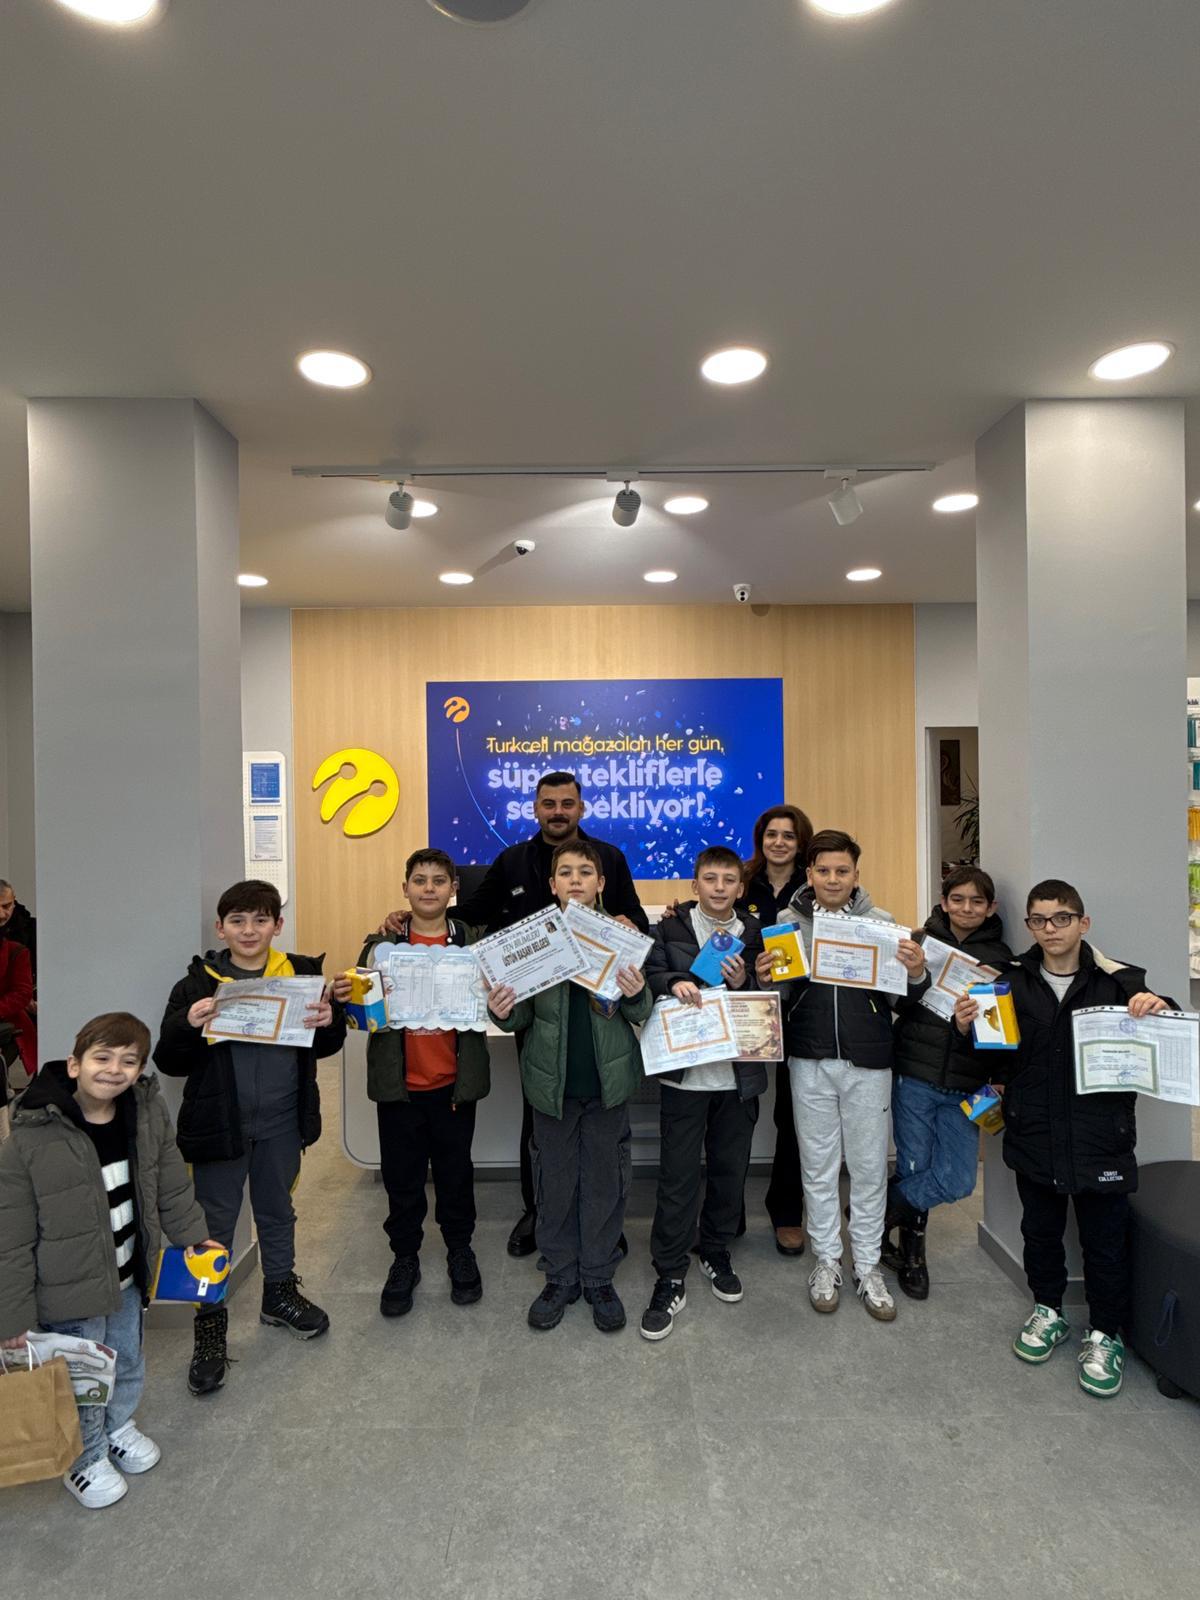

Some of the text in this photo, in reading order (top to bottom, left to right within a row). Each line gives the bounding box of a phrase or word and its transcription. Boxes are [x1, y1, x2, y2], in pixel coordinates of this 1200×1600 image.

[486, 735, 724, 756] Turkcell mağazaları her gün,
[488, 758, 723, 794] süp tekliflerle
